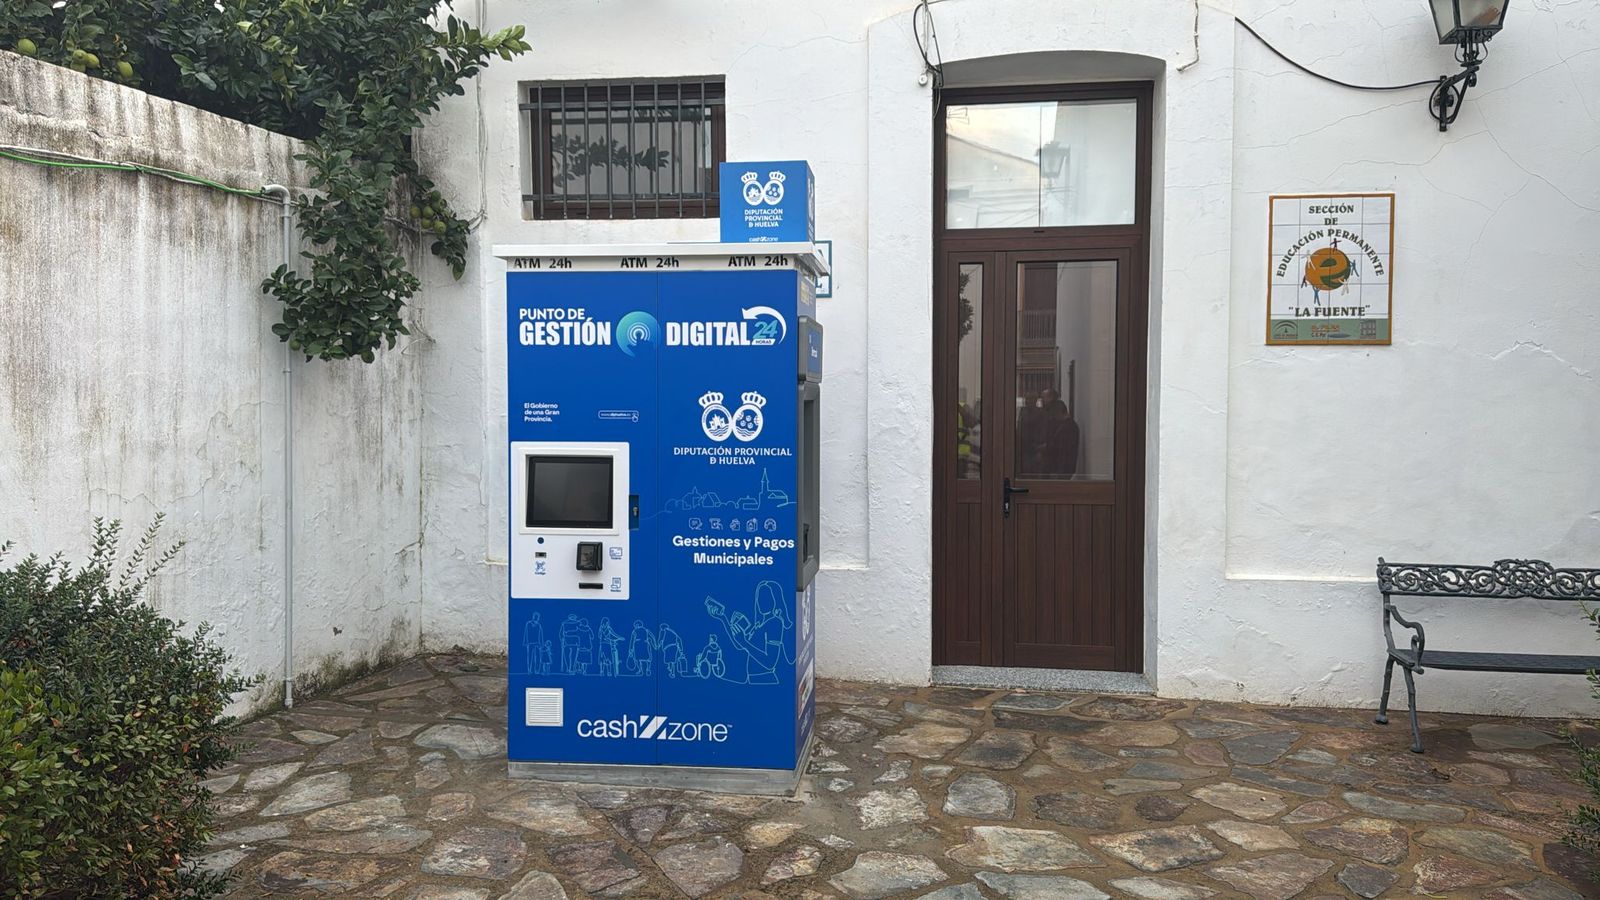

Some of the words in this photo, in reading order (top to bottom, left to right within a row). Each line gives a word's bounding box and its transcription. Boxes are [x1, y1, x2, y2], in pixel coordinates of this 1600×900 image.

[1308, 203, 1354, 214] SECCIÓN
[1324, 218, 1338, 226] DE
[1276, 229, 1324, 278] EDUCACIÓN
[1328, 228, 1385, 276] PERMANENTE
[514, 258, 540, 268] ATM
[549, 258, 572, 268] 24h
[620, 258, 648, 268] ATM
[656, 257, 680, 268] 24h
[728, 256, 756, 267] ATM
[764, 256, 788, 266] 24h
[520, 308, 565, 320] PUNTO
[568, 308, 585, 320] DE
[520, 317, 611, 346] GESTIÓN
[666, 322, 751, 346] DIGITAL
[752, 320, 778, 340] 24
[674, 446, 732, 456] DIPUTACIÓN
[734, 447, 792, 456] PROVINCIAL
[672, 535, 740, 548] Gestiones
[744, 538, 752, 550] y
[754, 536, 795, 551] Pagos
[694, 552, 774, 567] Municipales
[577, 714, 638, 738] cash
